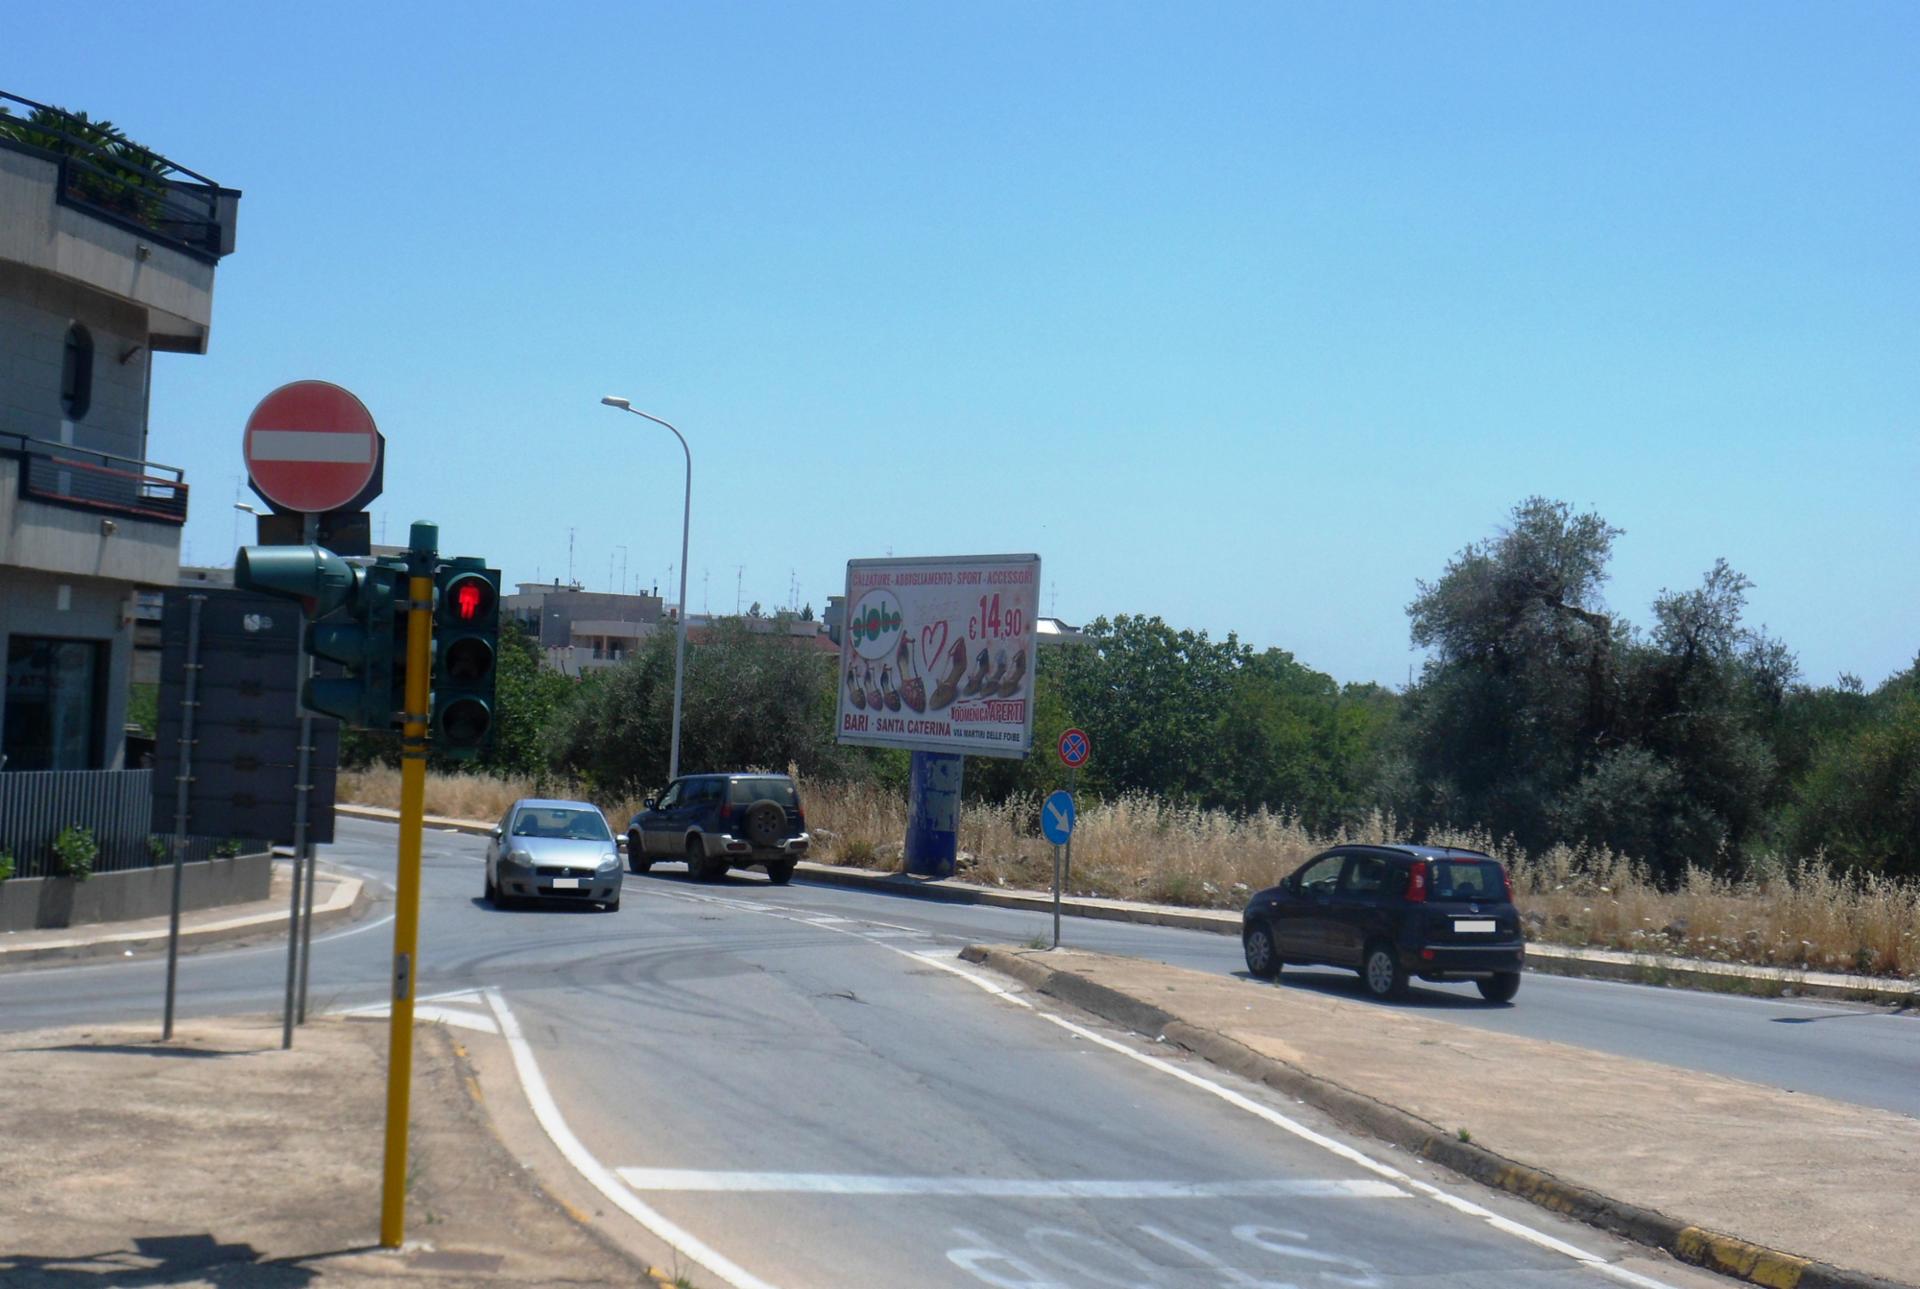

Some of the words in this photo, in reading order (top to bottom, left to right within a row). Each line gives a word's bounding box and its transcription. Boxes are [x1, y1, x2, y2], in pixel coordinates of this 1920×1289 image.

[853, 572, 891, 586] CALZATURE
[957, 570, 982, 585] SPORT
[987, 568, 1033, 584] ACCESSORI
[955, 706, 988, 722] DOMENICA
[990, 702, 1023, 721] APERTI
[844, 713, 868, 732] BARI
[876, 717, 905, 733] SANTA
[907, 719, 950, 737] CATERINA
[953, 728, 962, 737] VIA
